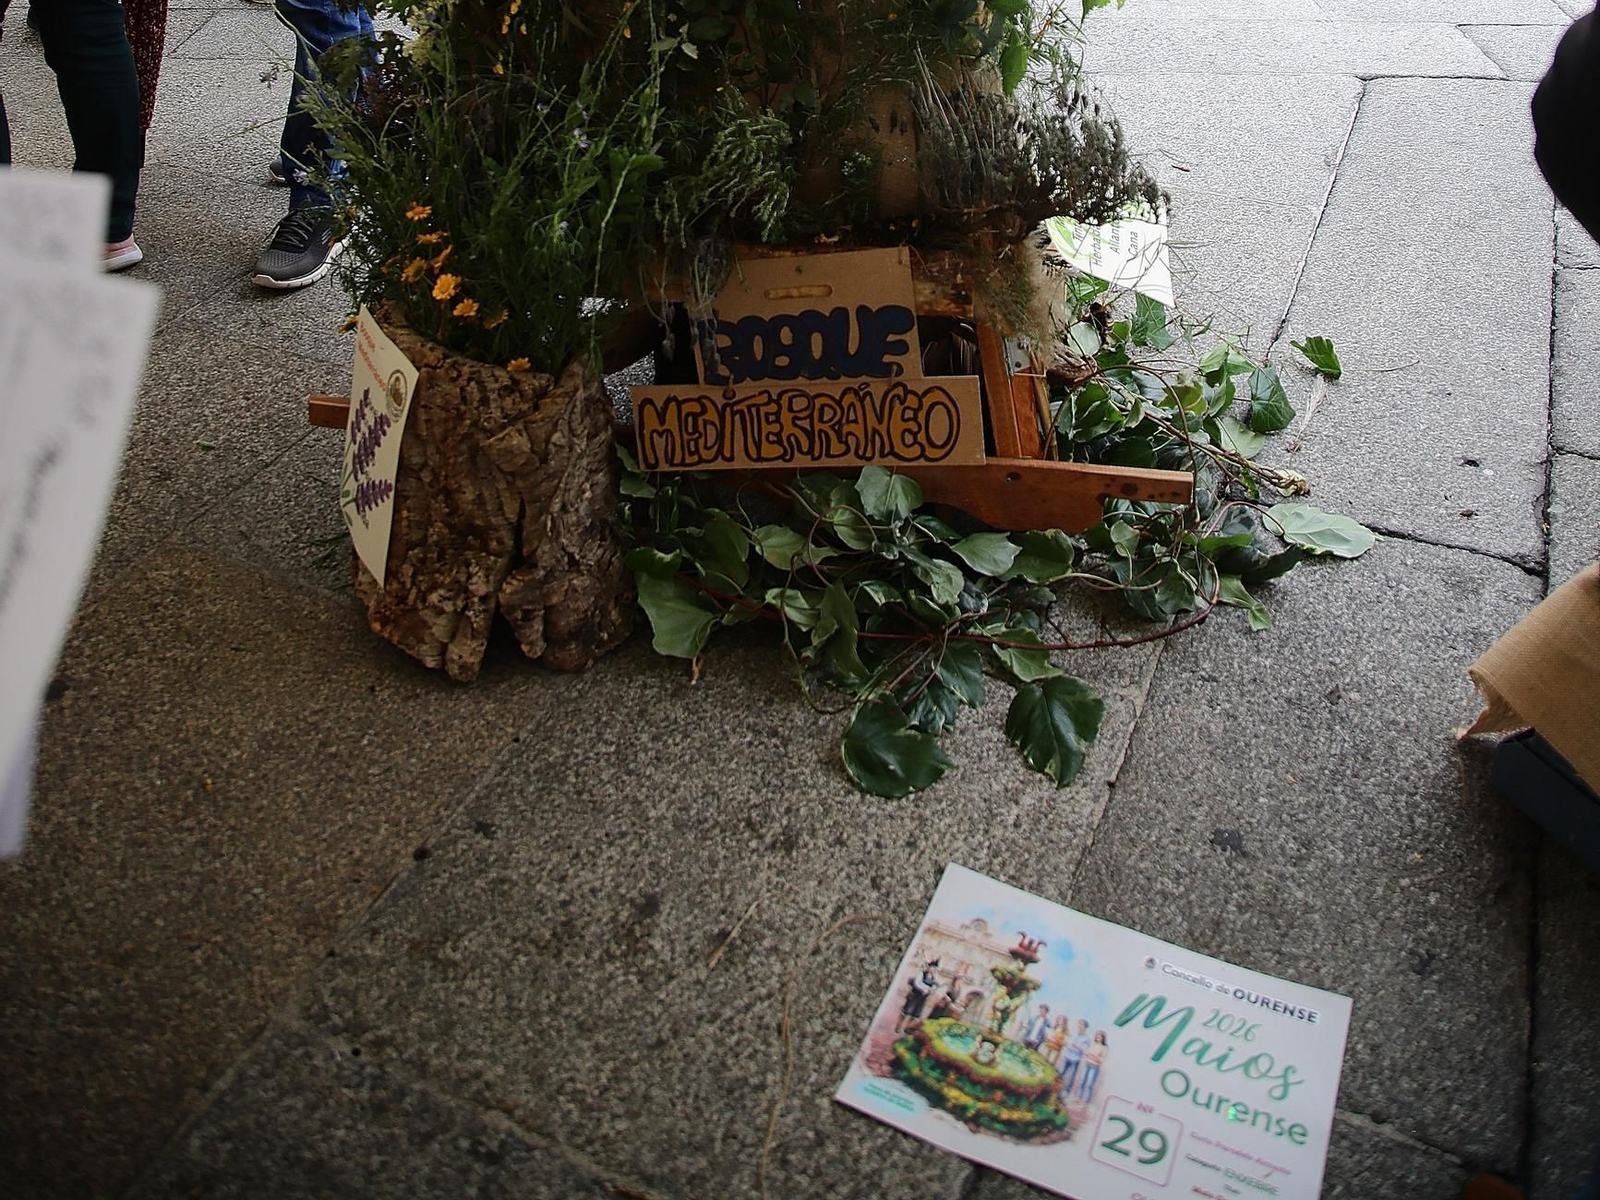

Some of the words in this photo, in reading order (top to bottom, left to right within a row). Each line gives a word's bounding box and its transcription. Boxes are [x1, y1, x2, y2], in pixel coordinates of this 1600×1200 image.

[1091, 238, 1102, 267] Herba
[1128, 231, 1138, 257] Cana
[1161, 963, 1213, 989] Concello
[1216, 980, 1231, 995] de
[1232, 987, 1319, 1024] OURENSE
[1113, 993, 1305, 1101] Maios
[1203, 1007, 1263, 1042] 2026
[1160, 1069, 1309, 1146] Ourense
[1100, 1114, 1170, 1166] 29
